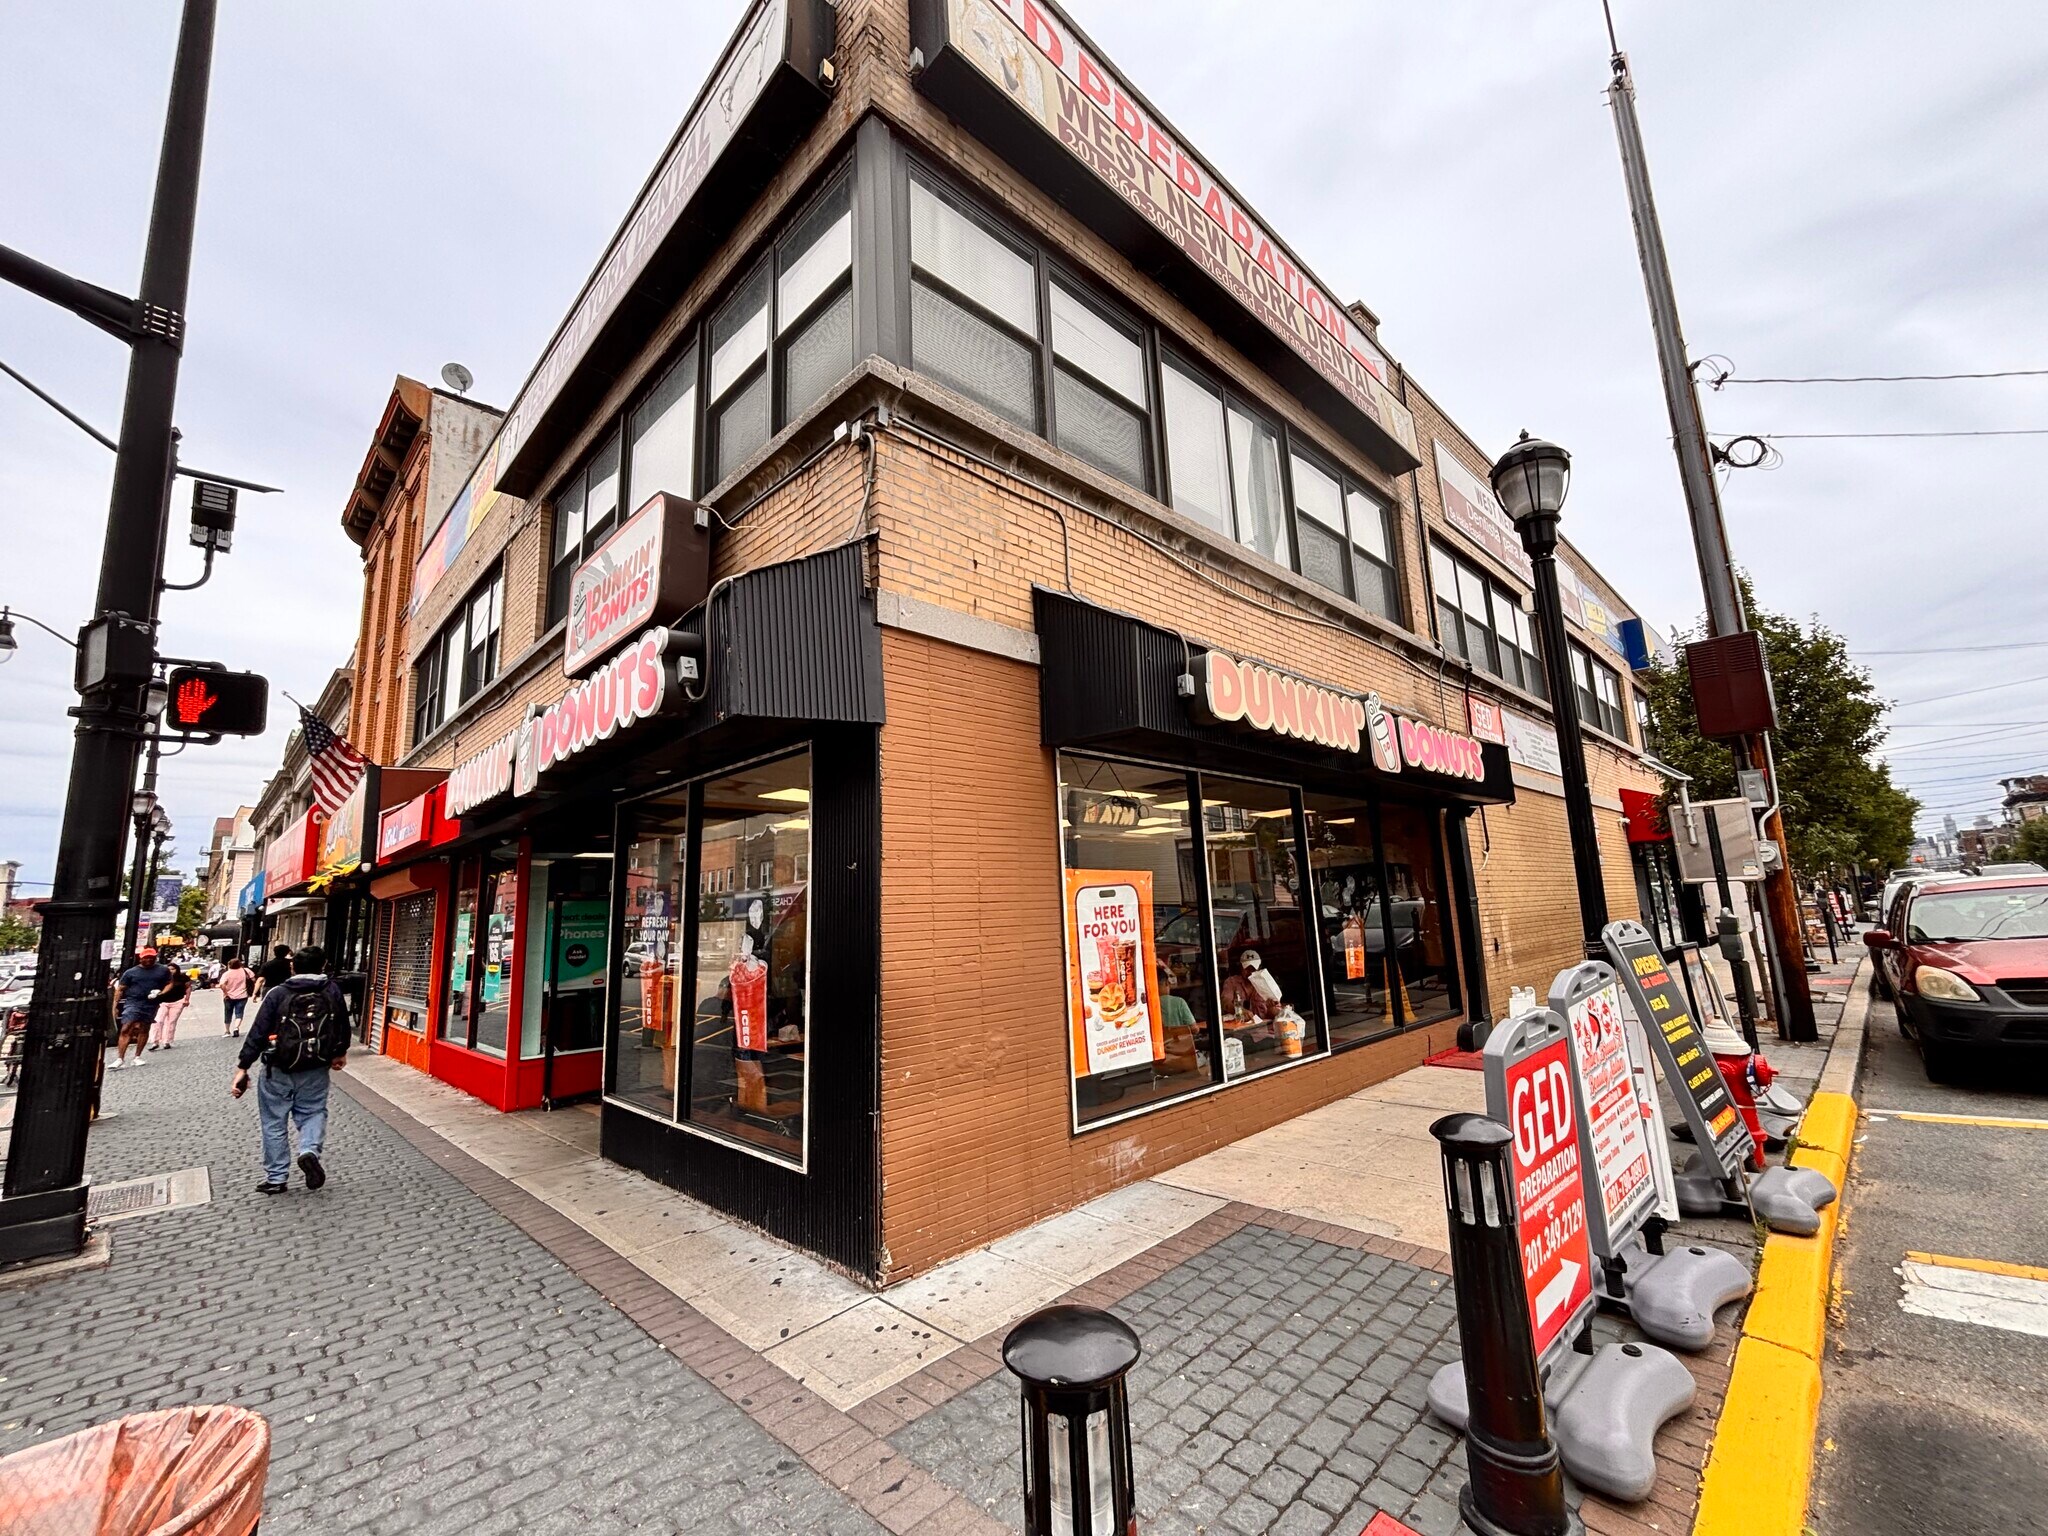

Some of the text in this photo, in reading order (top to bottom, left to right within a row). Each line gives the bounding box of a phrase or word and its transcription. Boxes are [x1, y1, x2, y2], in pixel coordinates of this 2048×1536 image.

[633, 114, 710, 255] DENTAL
[1055, 72, 1376, 400] WEST NEW YORK DENTAL
[1065, 128, 1185, 248] 201-866-3000
[1201, 253, 1256, 310] Medicaid
[1263, 309, 1311, 364] Insurance
[1318, 359, 1346, 391] Union
[1466, 501, 1500, 543] Dentista
[1474, 486, 1496, 519] WEST
[588, 570, 649, 641] DONUTS
[591, 535, 655, 612] DUNKIN'
[540, 640, 659, 765] DONUTS
[1210, 654, 1363, 751] DUNKIN'
[1400, 719, 1482, 779] DONUTS
[640, 930, 670, 941] YOUR DAY
[641, 916, 668, 928] REFRESH
[1084, 919, 1136, 938] FOR YOU
[1094, 905, 1125, 920] HERE
[741, 1009, 750, 1047] ICED
[1119, 1035, 1146, 1048] REWARDS
[1512, 1060, 1571, 1167] GED
[1519, 1143, 1577, 1207] PREPARATION
[1525, 1198, 1583, 1280] 201.349.2129
